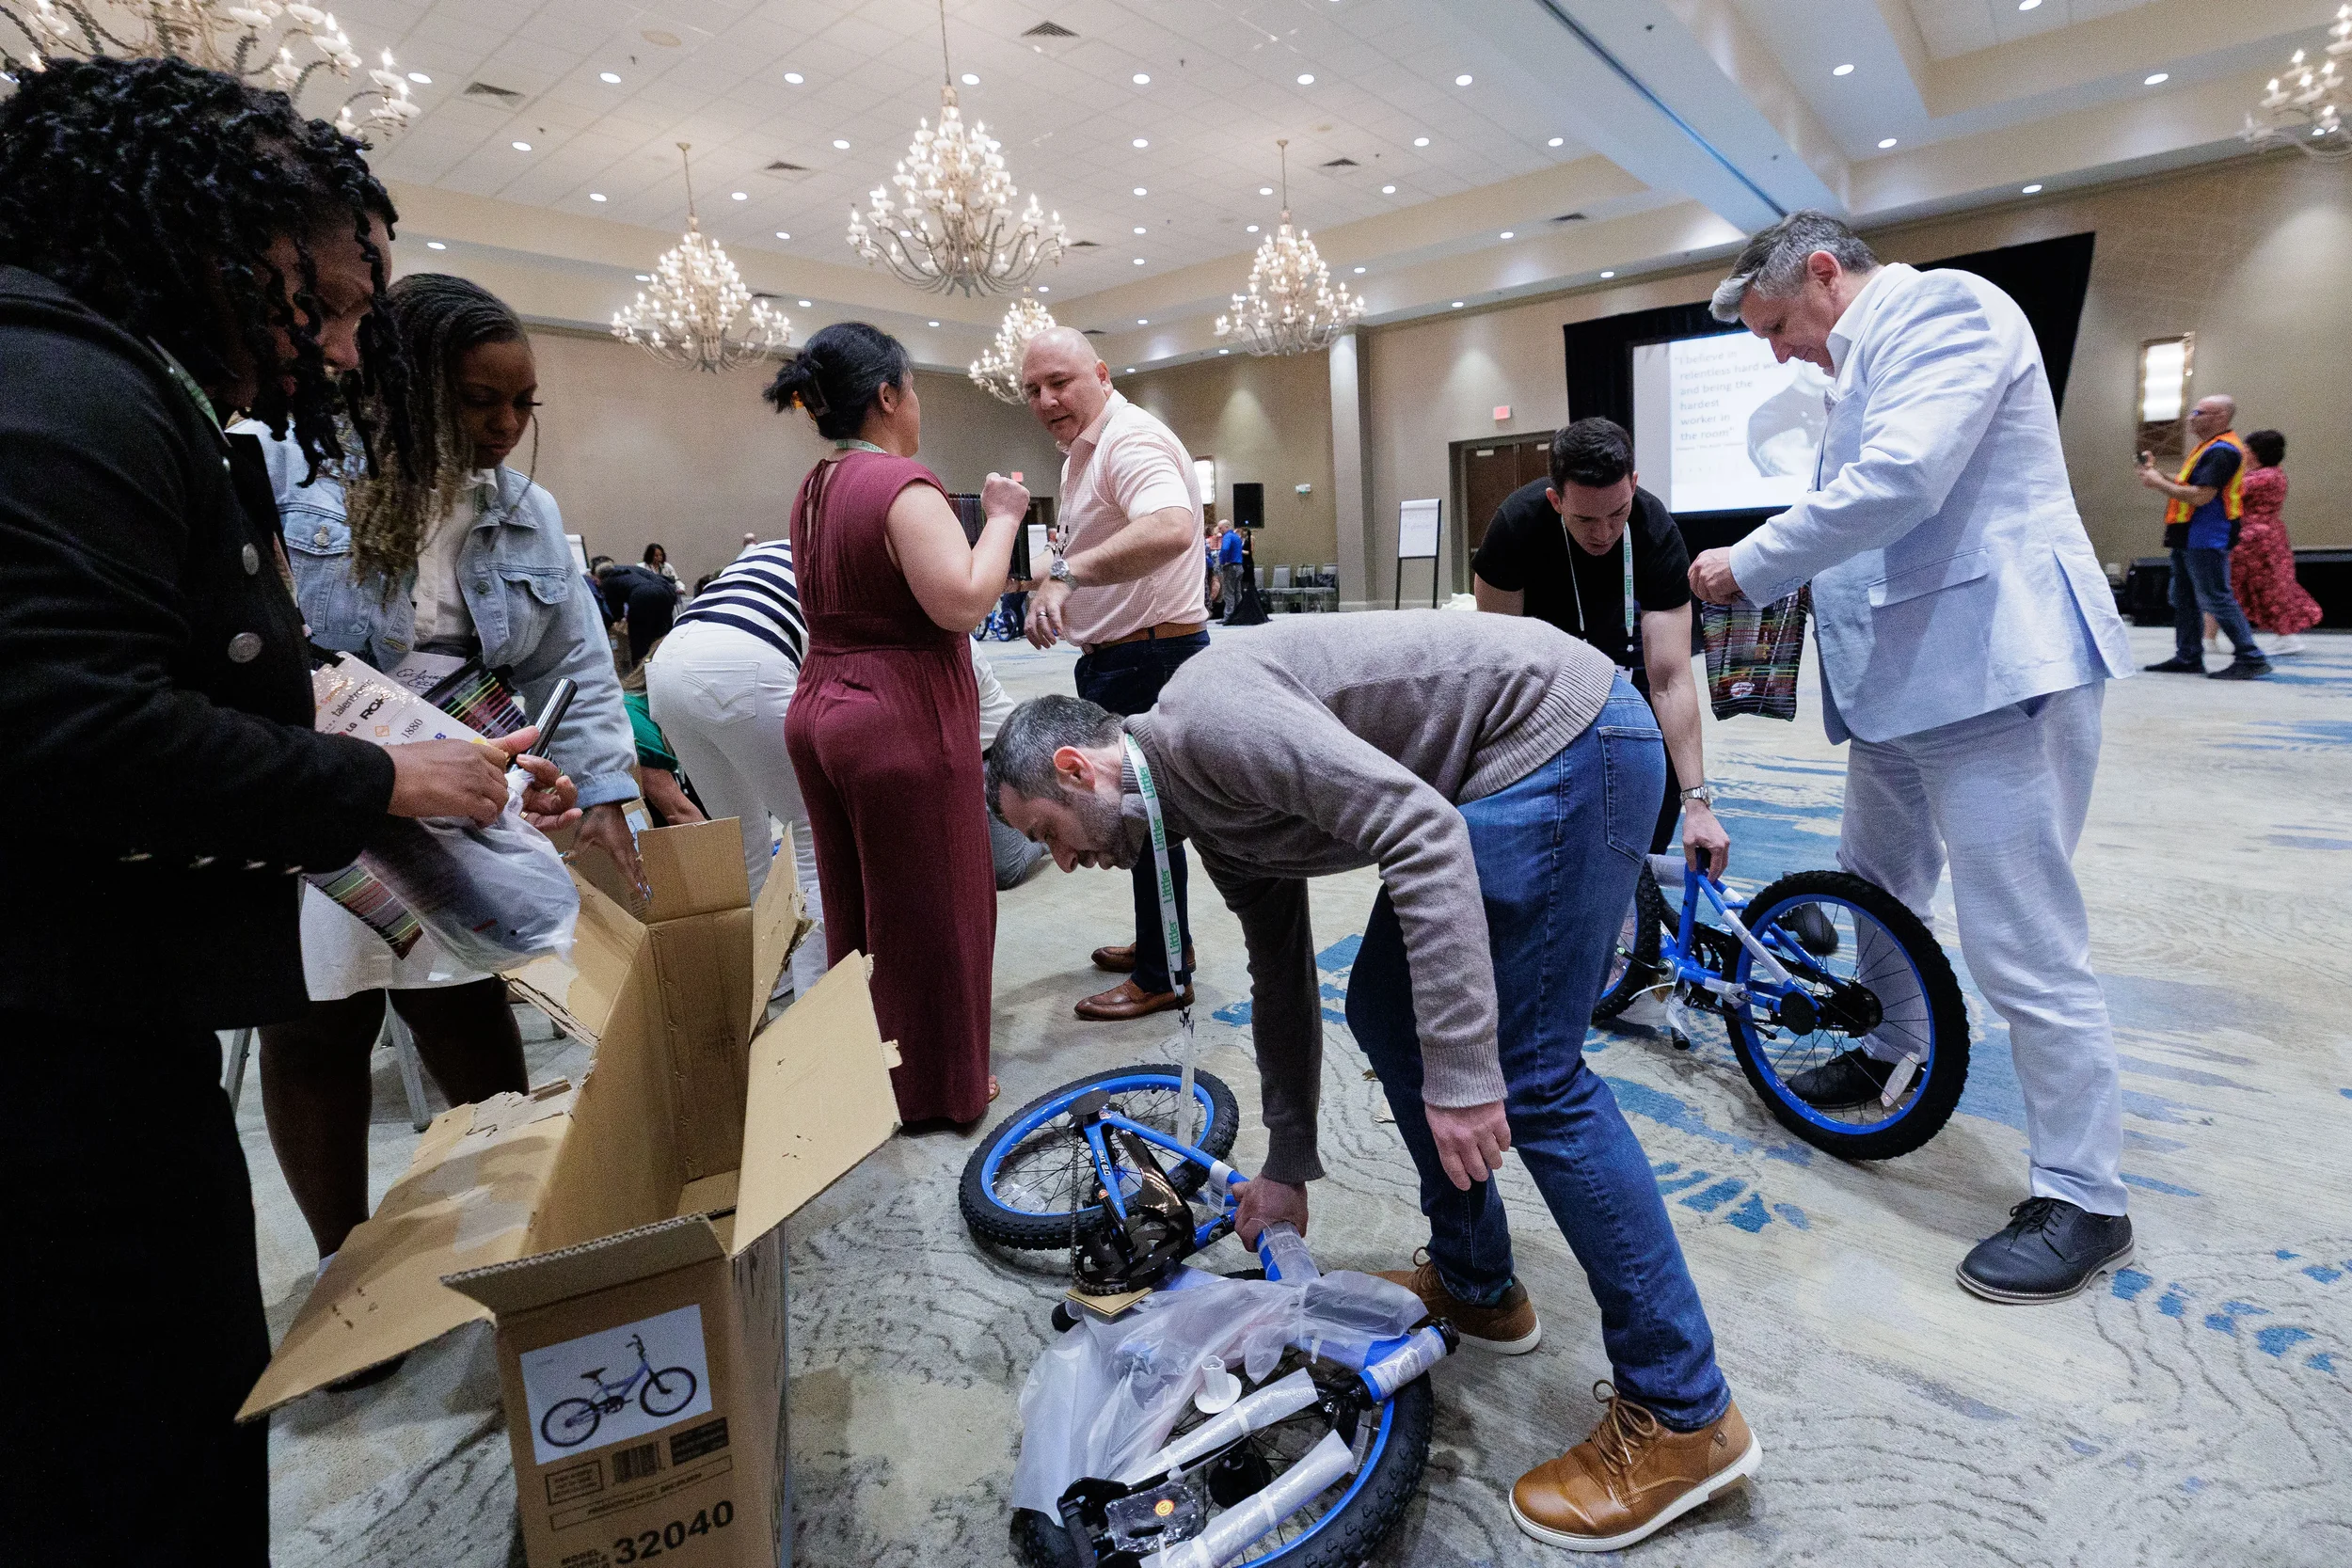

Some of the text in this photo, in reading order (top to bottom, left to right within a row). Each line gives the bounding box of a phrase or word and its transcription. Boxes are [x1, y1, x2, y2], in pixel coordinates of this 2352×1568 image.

[1686, 353, 1724, 365] believe
[1679, 360, 1789, 380] relentless hard wo
[1679, 380, 1753, 396] and being the
[1679, 399, 1720, 410] hardest
[1680, 414, 1717, 425] worker
[1680, 432, 1698, 440] the
[345, 721, 358, 733] LG
[401, 718, 423, 739] 1880
[1138, 764, 1156, 800] Littler
[1153, 816, 1166, 852] Littler
[1161, 867, 1174, 904] Littler
[1168, 920, 1181, 955] Littler
[613, 1499, 735, 1565] 32040
